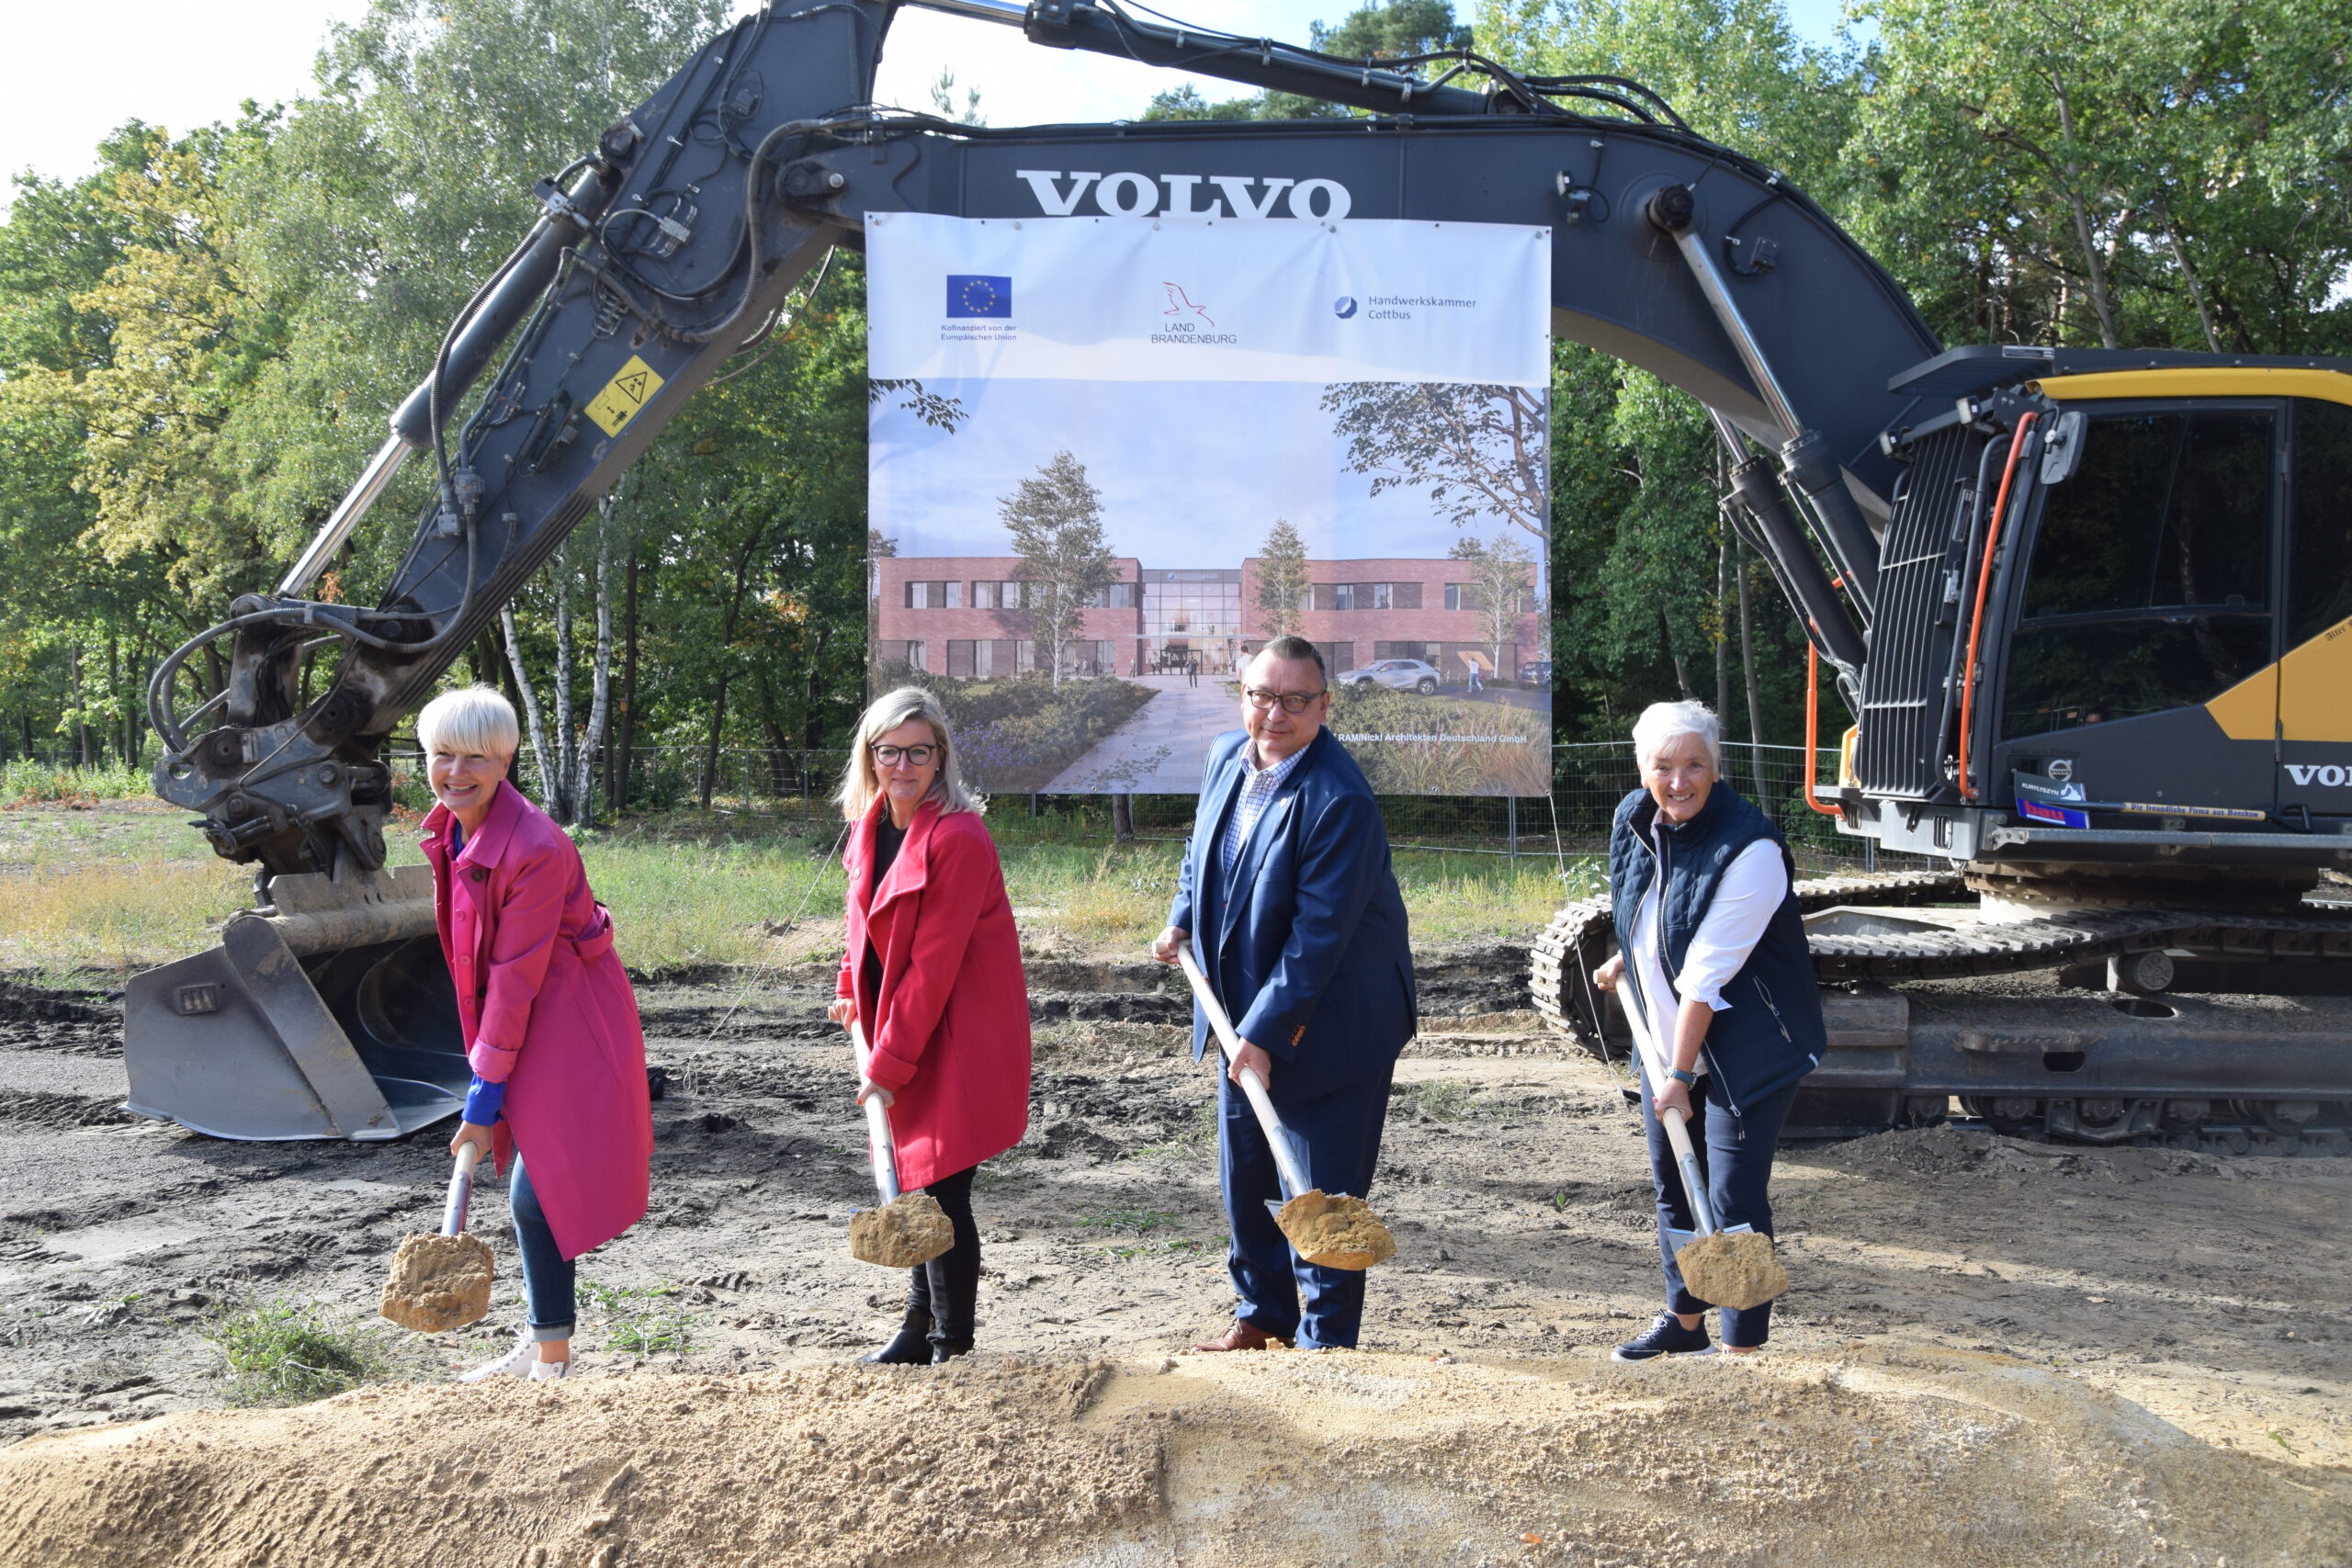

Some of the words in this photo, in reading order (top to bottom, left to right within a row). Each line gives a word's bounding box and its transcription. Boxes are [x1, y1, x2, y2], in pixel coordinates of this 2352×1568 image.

[1016, 170, 1351, 219] VOLVO
[1368, 296, 1477, 308] Handwerkskammer
[1368, 310, 1411, 320] Cottbus
[1165, 323, 1195, 332] LAND
[941, 333, 993, 342] Europäischen
[1151, 334, 1238, 344] BRANDENBURG
[1385, 733, 1437, 742] Architekten
[1440, 734, 1497, 743] Deutschland
[1498, 735, 1527, 743] GmbH
[2284, 764, 2352, 787] VO
[2024, 800, 2064, 820] bau
